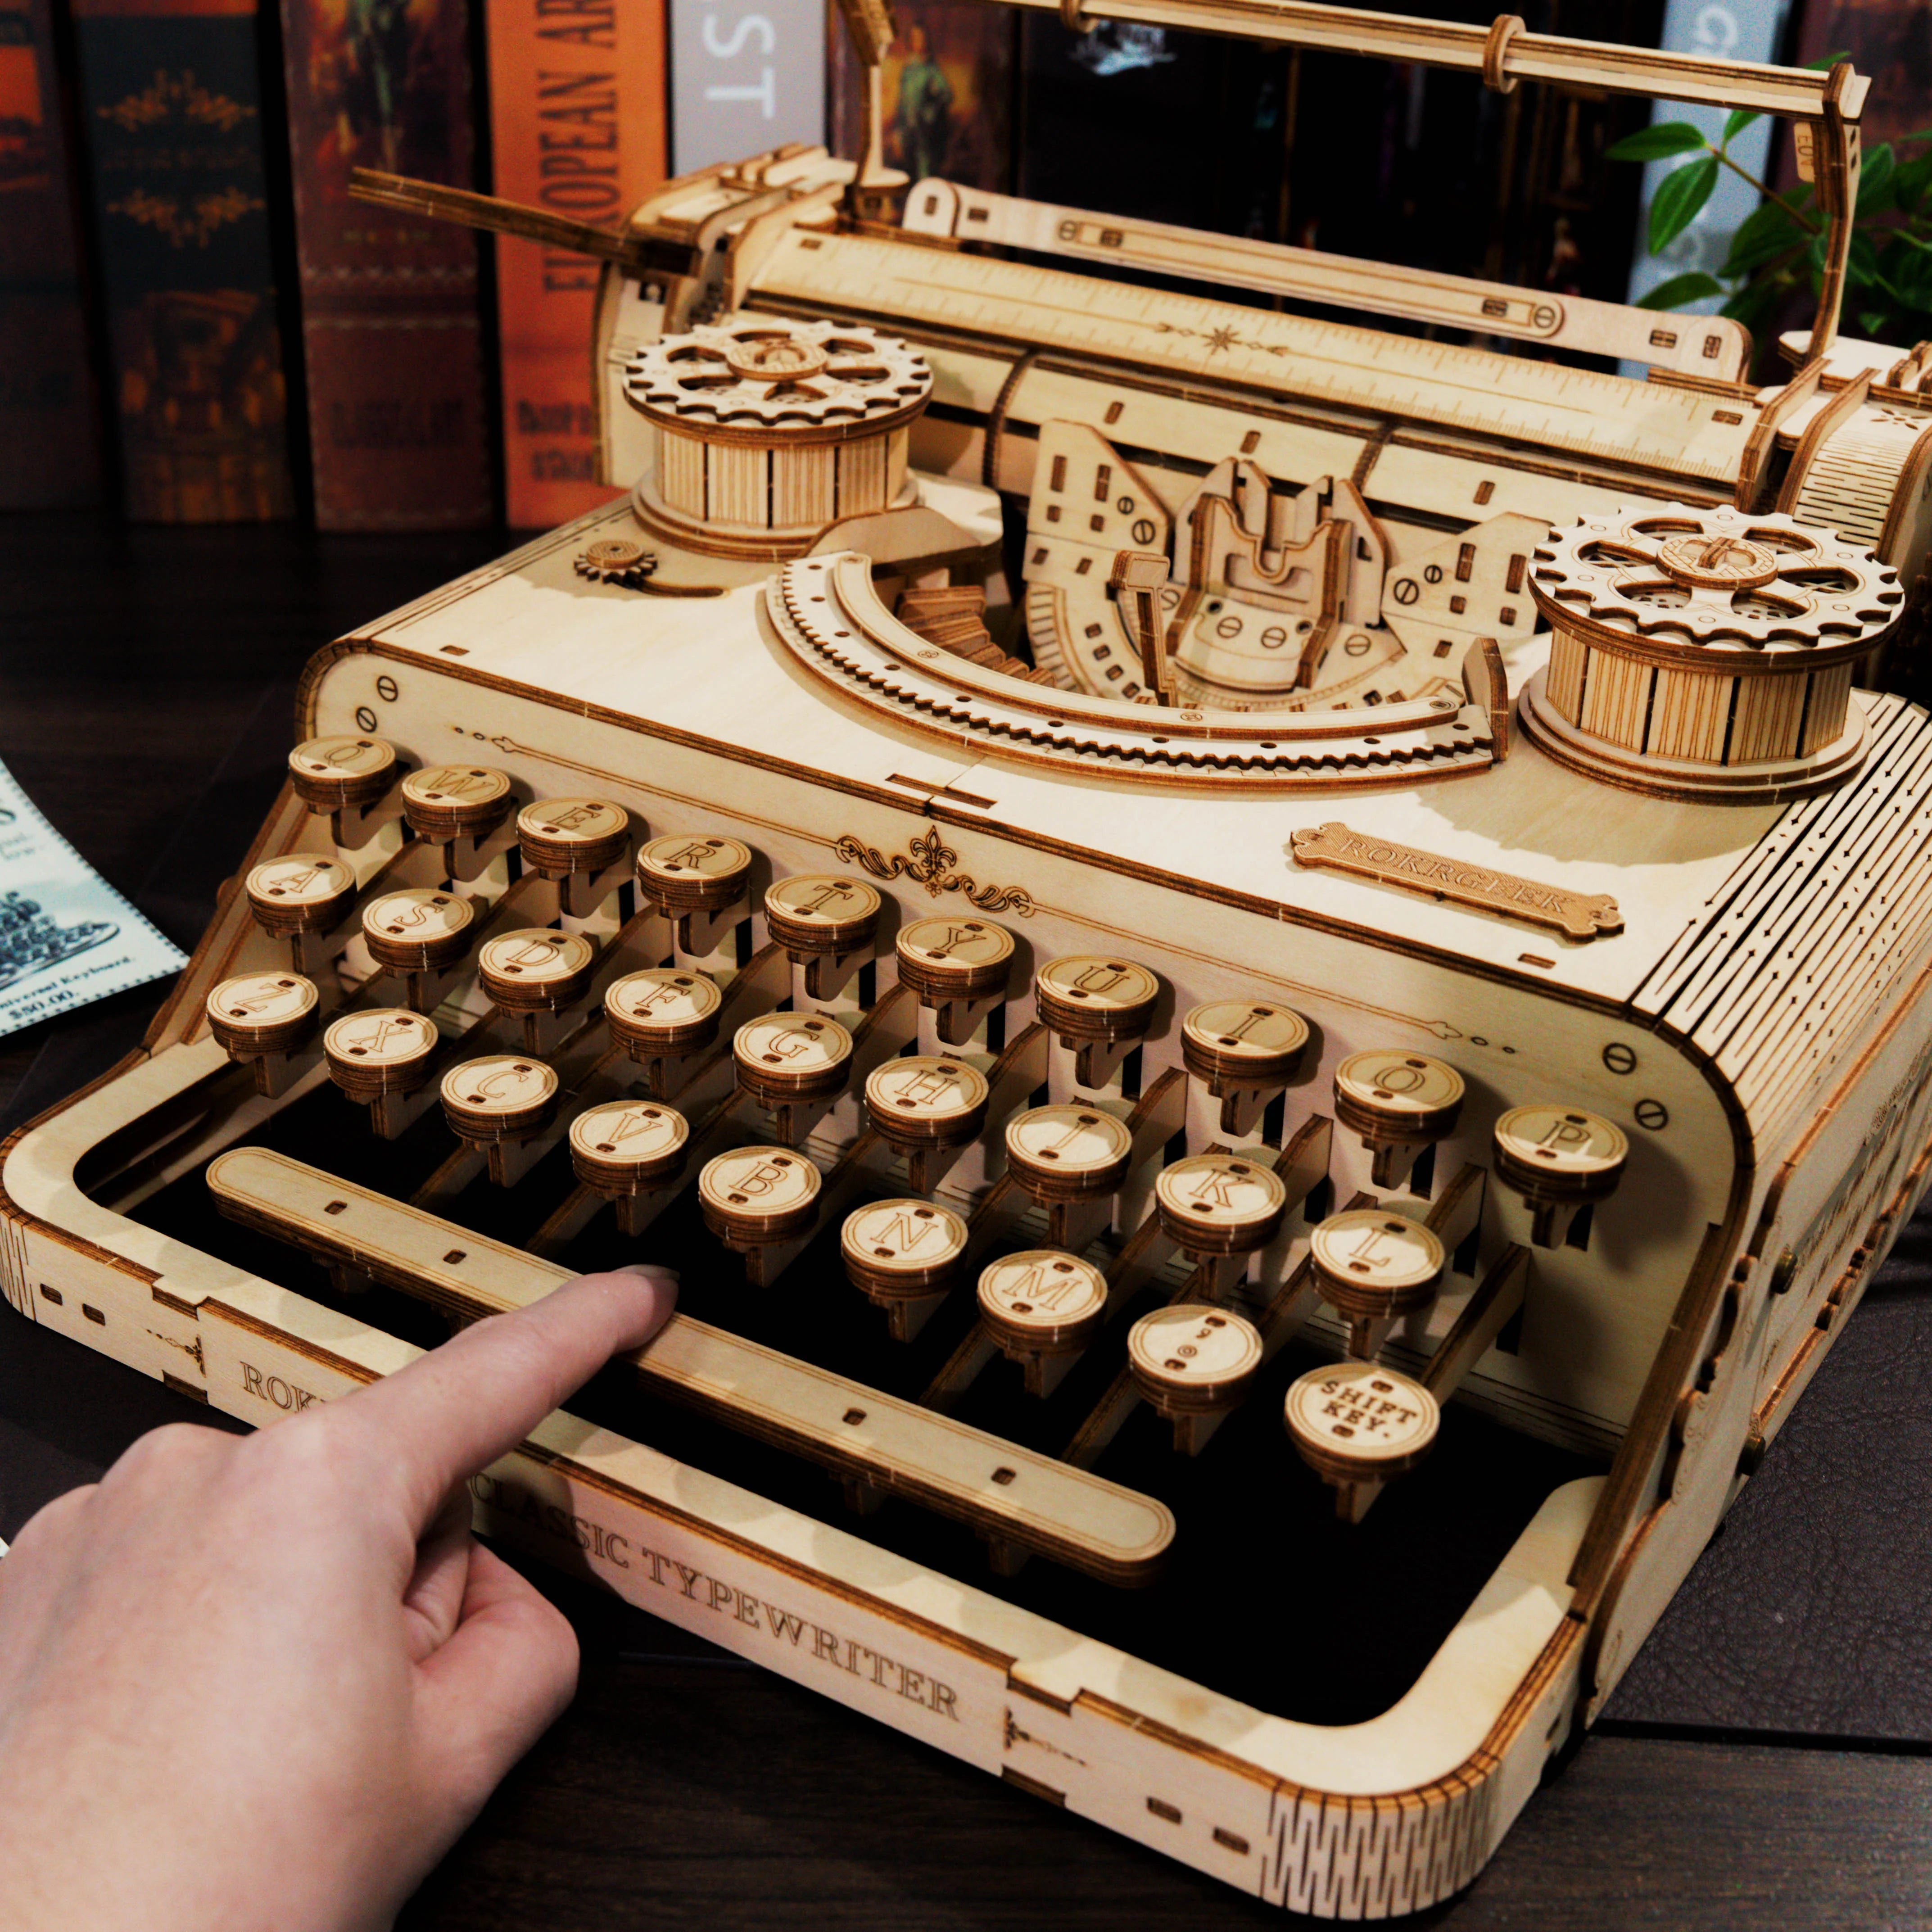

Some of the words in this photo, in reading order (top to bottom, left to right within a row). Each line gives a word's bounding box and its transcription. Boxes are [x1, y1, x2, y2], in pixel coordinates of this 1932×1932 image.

[539, 70, 620, 292] EOPEAN
[428, 769, 495, 795] W
[547, 807, 601, 829] E
[664, 843, 716, 869] R
[268, 869, 321, 893] A
[1339, 839, 1575, 914] ROKRGEEK
[803, 885, 854, 910] T
[394, 902, 443, 927] S
[506, 939, 560, 967] D
[934, 928, 986, 954] Y
[1074, 965, 1130, 992] U
[233, 982, 293, 1012] Z
[635, 981, 691, 1009] F
[348, 1020, 413, 1053] X
[1225, 1013, 1266, 1040] I
[770, 1029, 820, 1058] G
[477, 1071, 530, 1099] C
[895, 1070, 961, 1105] H
[1374, 1066, 1425, 1091] O
[609, 1112, 663, 1143] V
[1538, 1121, 1591, 1148] P
[728, 1161, 788, 1196] B
[1189, 1169, 1255, 1208] K
[870, 1212, 938, 1252] N
[1349, 1227, 1391, 1266] L
[1002, 1263, 1084, 1311] M
[240, 1361, 326, 1413] ROK
[1321, 1380, 1417, 1423] SHIFT
[471, 1472, 629, 1569] CLASSIC
[642, 1547, 959, 1722] TYPEWRITER
